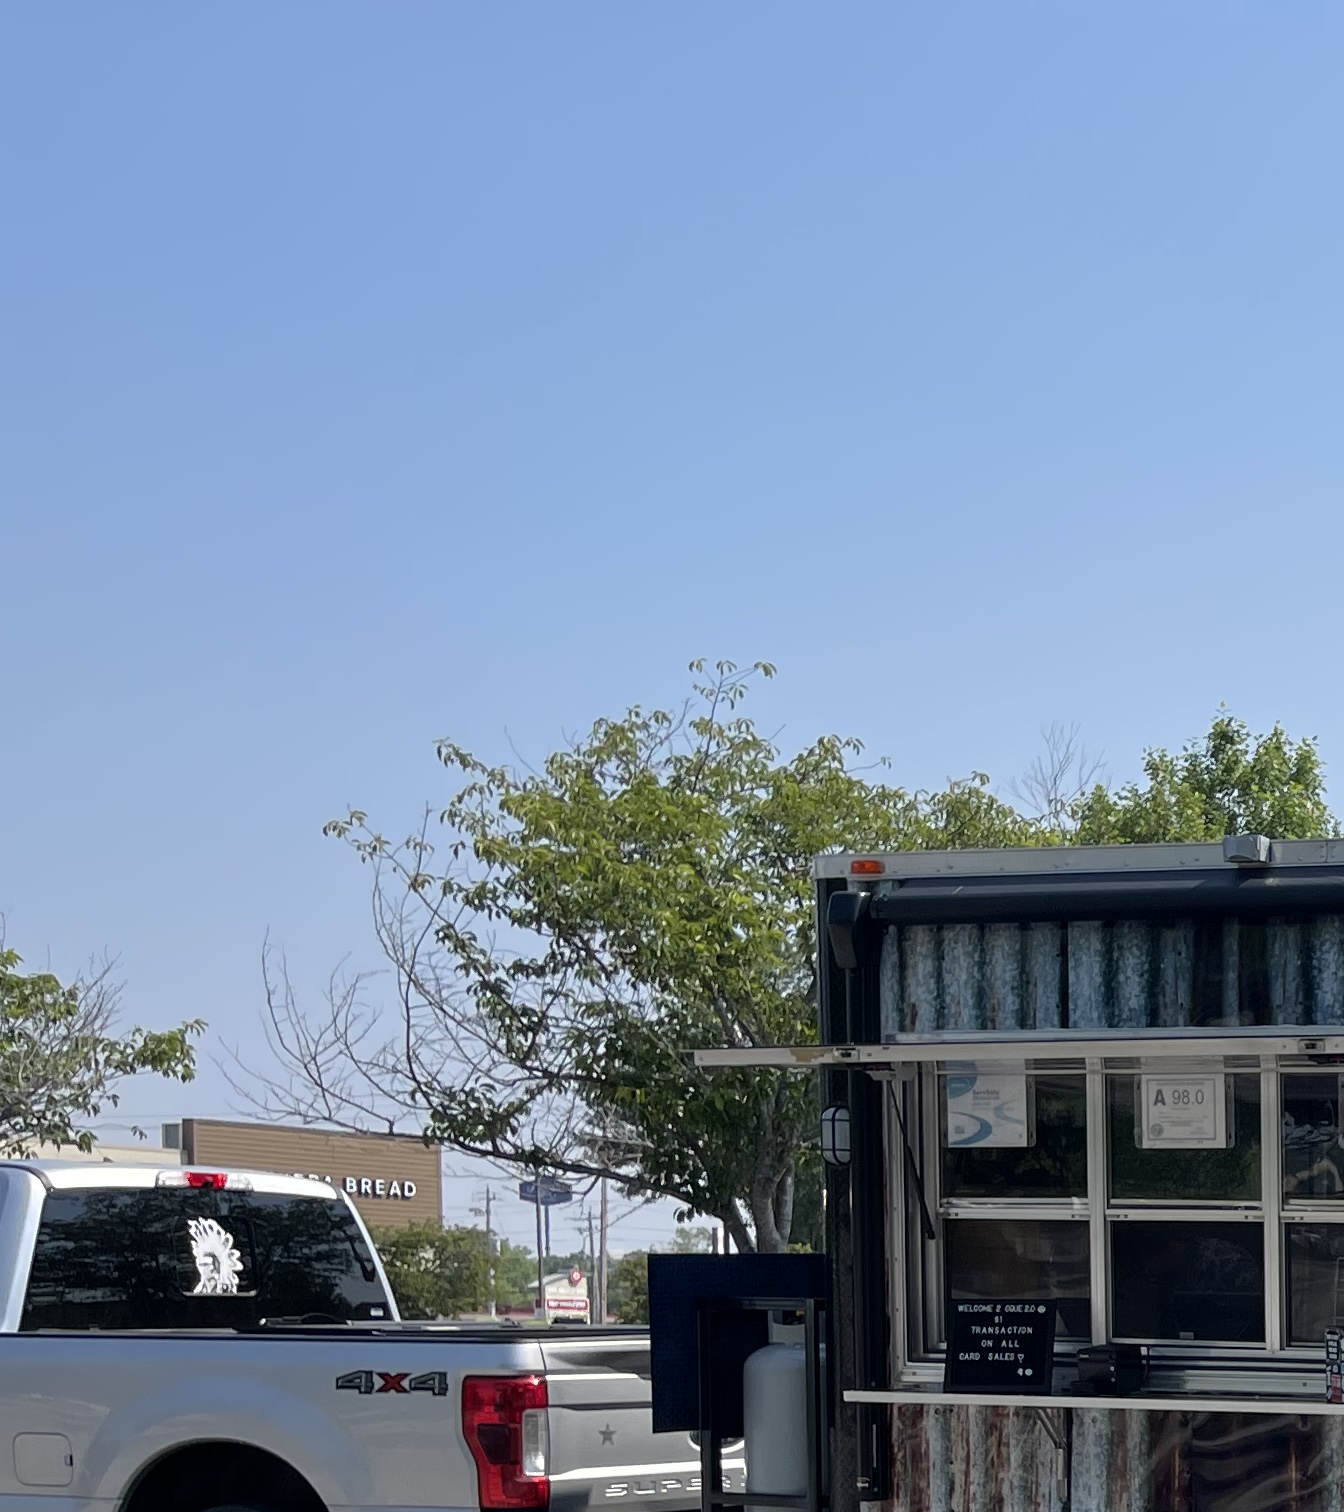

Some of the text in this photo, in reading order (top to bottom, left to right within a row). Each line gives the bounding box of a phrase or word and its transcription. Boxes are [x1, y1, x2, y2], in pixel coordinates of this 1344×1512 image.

[1153, 1089, 1204, 1106] A 98.0
[344, 1176, 418, 1199] BREAD
[958, 1304, 993, 1312] WELCOME
[971, 1326, 1033, 1334] TRANSACTION
